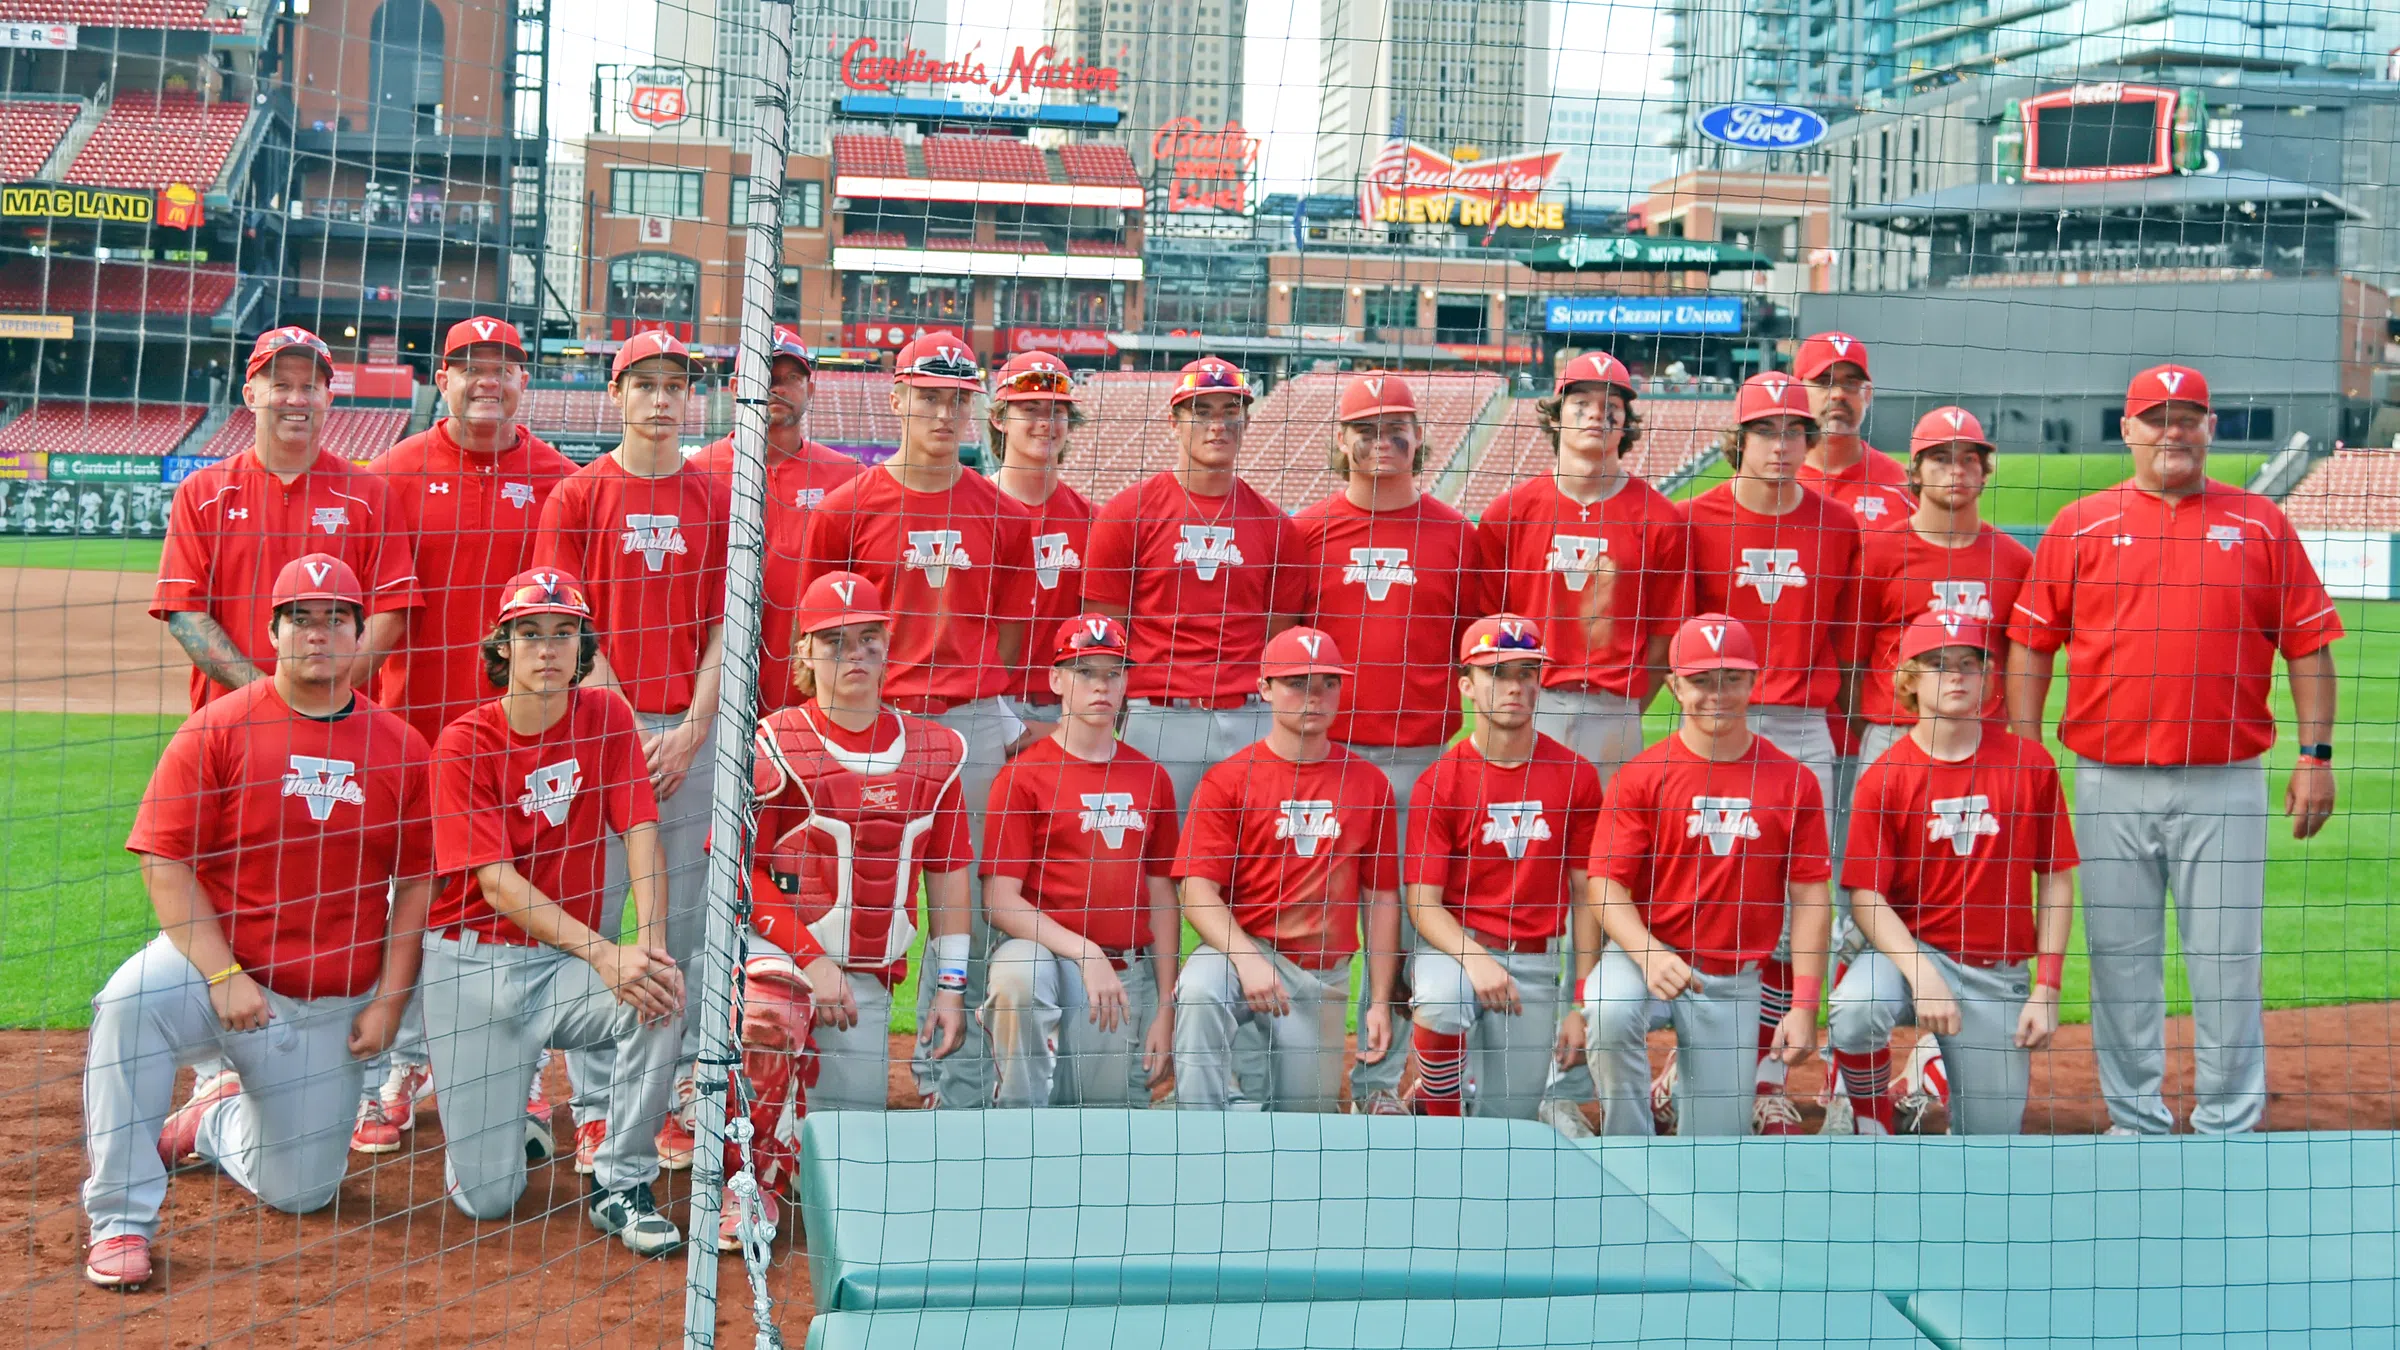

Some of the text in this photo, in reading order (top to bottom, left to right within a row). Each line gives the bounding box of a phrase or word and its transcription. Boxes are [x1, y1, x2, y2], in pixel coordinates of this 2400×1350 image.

[636, 74, 682, 85] PHILLIPS
[990, 45, 1119, 96] Nation
[638, 92, 680, 117] 66
[962, 102, 1040, 118] ROOFTOP
[1723, 106, 1803, 142] Ford
[1152, 117, 1262, 171] Bally
[1375, 196, 1565, 230] BREW HOUSE
[1649, 246, 1682, 262] MVP
[1684, 246, 1718, 262] Deck
[282, 330, 308, 343] V
[472, 321, 498, 341] V
[650, 334, 672, 352] V
[1828, 336, 1851, 356] V
[937, 347, 961, 367] V
[1589, 357, 1612, 375] V
[1201, 364, 1225, 380] V
[2157, 372, 2184, 394] V
[1363, 379, 1383, 398] V
[1762, 380, 1788, 403] V
[1942, 412, 1965, 431] V
[72, 461, 121, 475] Central
[123, 462, 160, 475] Bank
[622, 530, 687, 555] Vandals
[1174, 542, 1244, 565] Vandals
[904, 546, 972, 570] Vandals
[304, 562, 331, 587] V
[532, 573, 559, 594] V
[1343, 564, 1417, 585] Vandals
[830, 581, 856, 606] V
[1086, 619, 1107, 641] V
[1501, 622, 1523, 641] V
[1937, 614, 1962, 637] V
[1298, 635, 1321, 658] V
[1700, 625, 1725, 652] V
[281, 774, 366, 805] Vandals
[517, 776, 583, 817] Vandal
[862, 787, 898, 805] Rawlings
[1078, 811, 1145, 833] Vandals
[1275, 815, 1342, 840] Vandals
[1481, 819, 1551, 845] Vandals
[1686, 814, 1761, 840] Vandals
